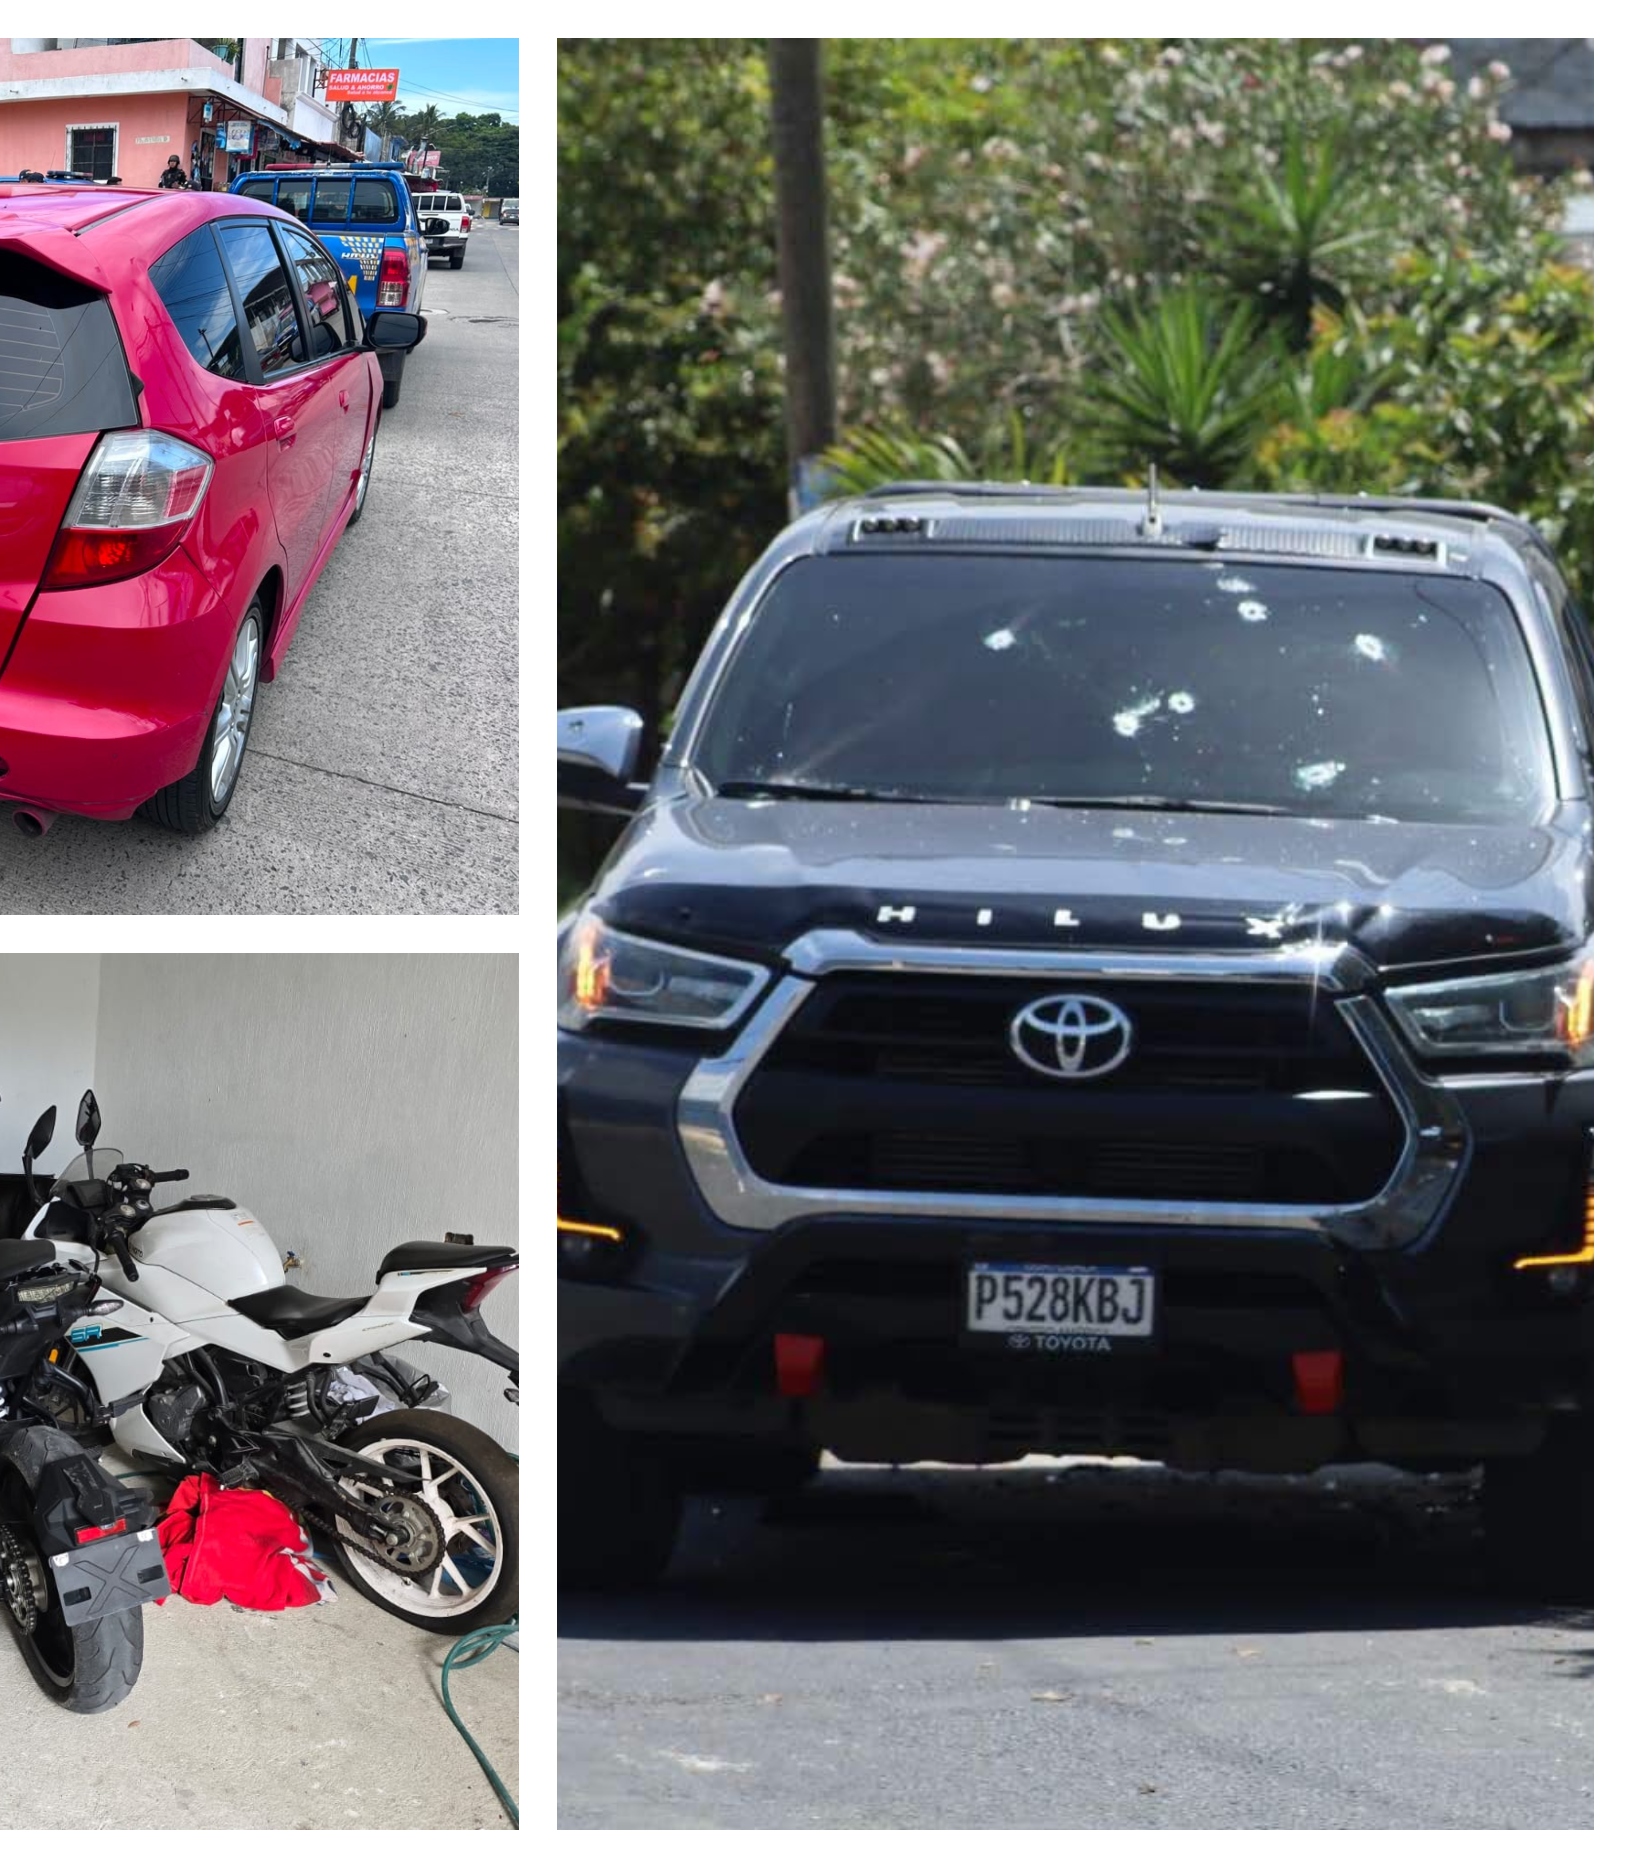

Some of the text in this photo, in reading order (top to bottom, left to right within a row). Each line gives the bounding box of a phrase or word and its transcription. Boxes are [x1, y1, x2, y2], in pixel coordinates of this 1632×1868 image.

[330, 73, 395, 83] FARMACIAS
[876, 904, 1286, 939] HILUX
[975, 1274, 1146, 1325] P528KBJ
[1035, 1335, 1112, 1351] TOYOTA
